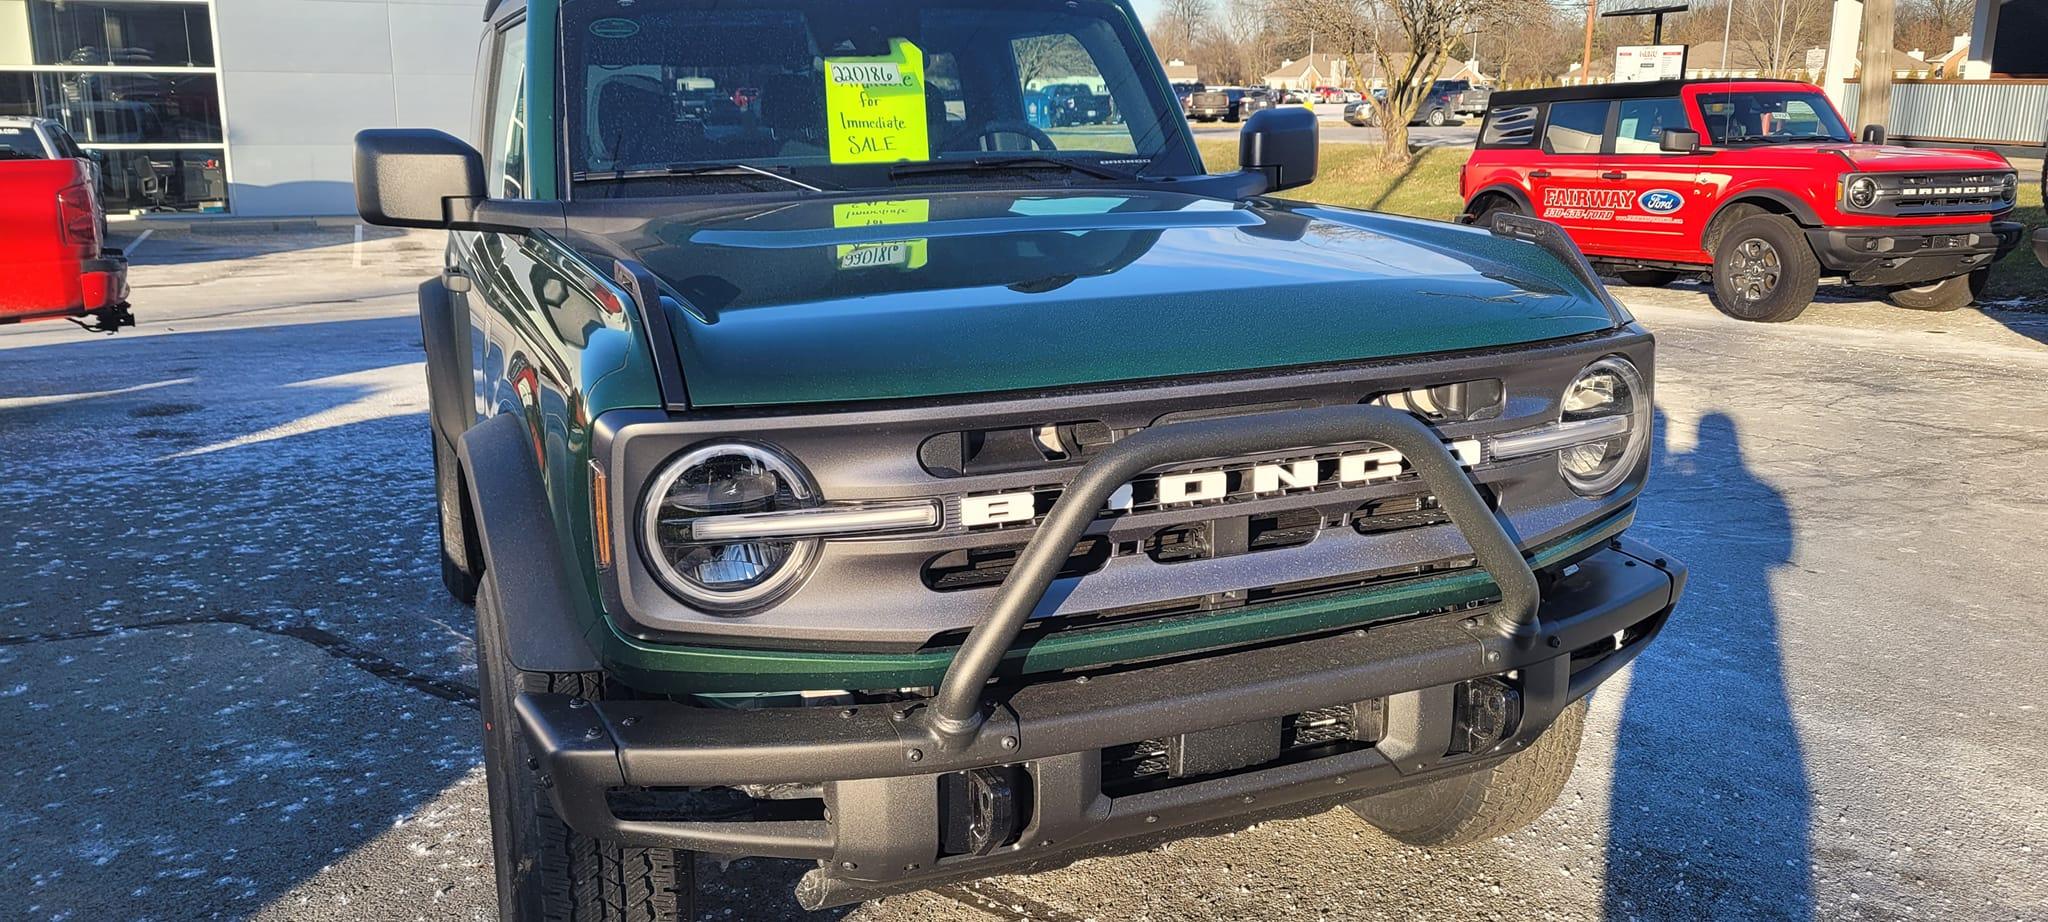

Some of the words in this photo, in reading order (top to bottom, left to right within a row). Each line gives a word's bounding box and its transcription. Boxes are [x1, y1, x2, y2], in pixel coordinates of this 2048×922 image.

[833, 65, 893, 83] 220186
[860, 91, 880, 107] for
[840, 112, 906, 131] Immediate
[848, 136, 897, 155] SALE
[1545, 188, 1636, 208] FAIRWAY
[1903, 186, 1989, 195] BRONCO
[1647, 193, 1673, 209] Ford
